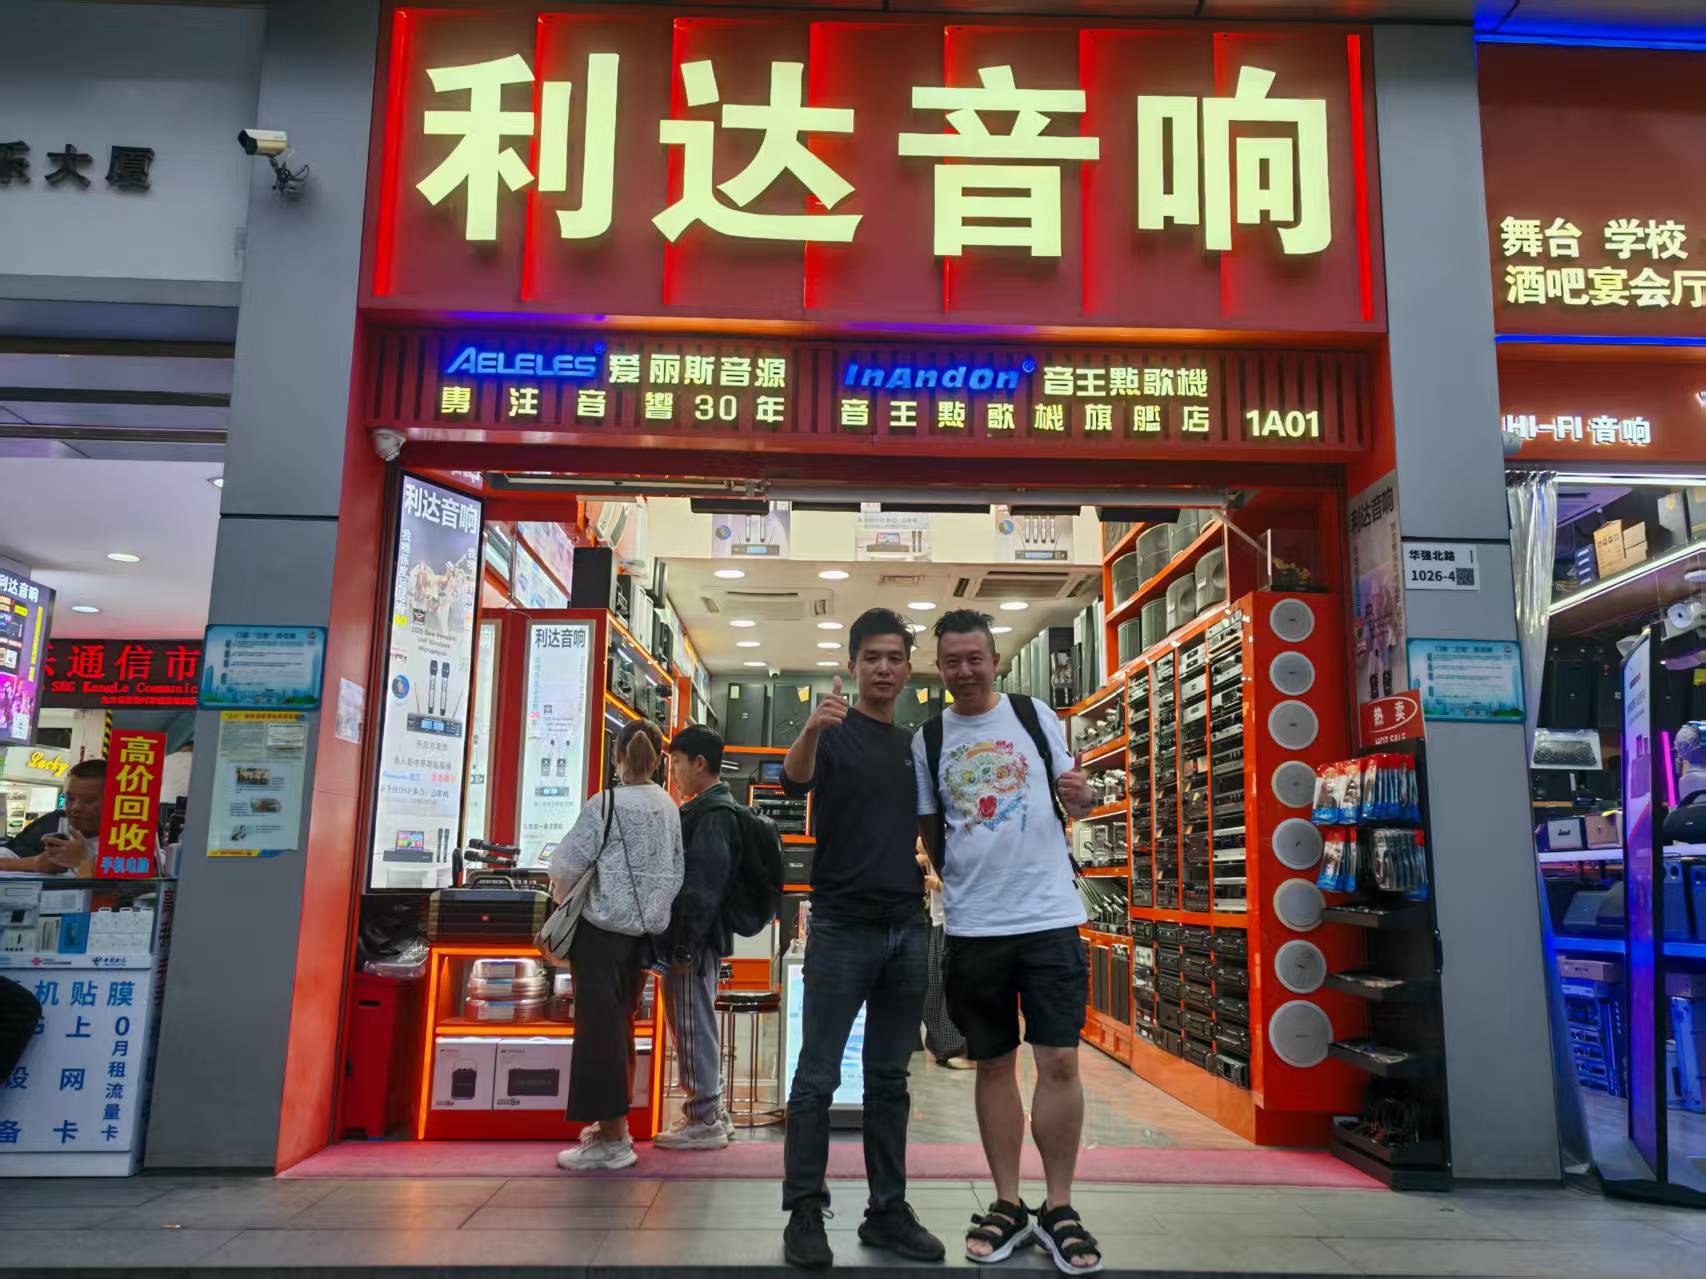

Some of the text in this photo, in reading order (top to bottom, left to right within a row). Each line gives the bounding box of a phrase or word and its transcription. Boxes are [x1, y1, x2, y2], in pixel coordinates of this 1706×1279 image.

[416, 52, 1333, 257] 利达音响
[1500, 216, 1689, 259] 舞台 学校
[1504, 264, 1706, 308] 酒吧宴会厅
[446, 347, 597, 376] AELELES
[608, 353, 786, 388] 爱丽斯音源
[1043, 366, 1208, 398] 音王點歌機
[1246, 410, 1320, 438] 1A01
[1588, 415, 1651, 445] 音响
[403, 483, 479, 534] 利达音响
[1350, 486, 1394, 534] 利达音响
[1408, 549, 1455, 562] 华强北路
[0, 573, 40, 603] 利达音响
[1411, 569, 1456, 582] 1026-4
[534, 628, 587, 649] 利达音响
[108, 736, 158, 852] 高价回收
[18, 981, 135, 1007] 机贴膜
